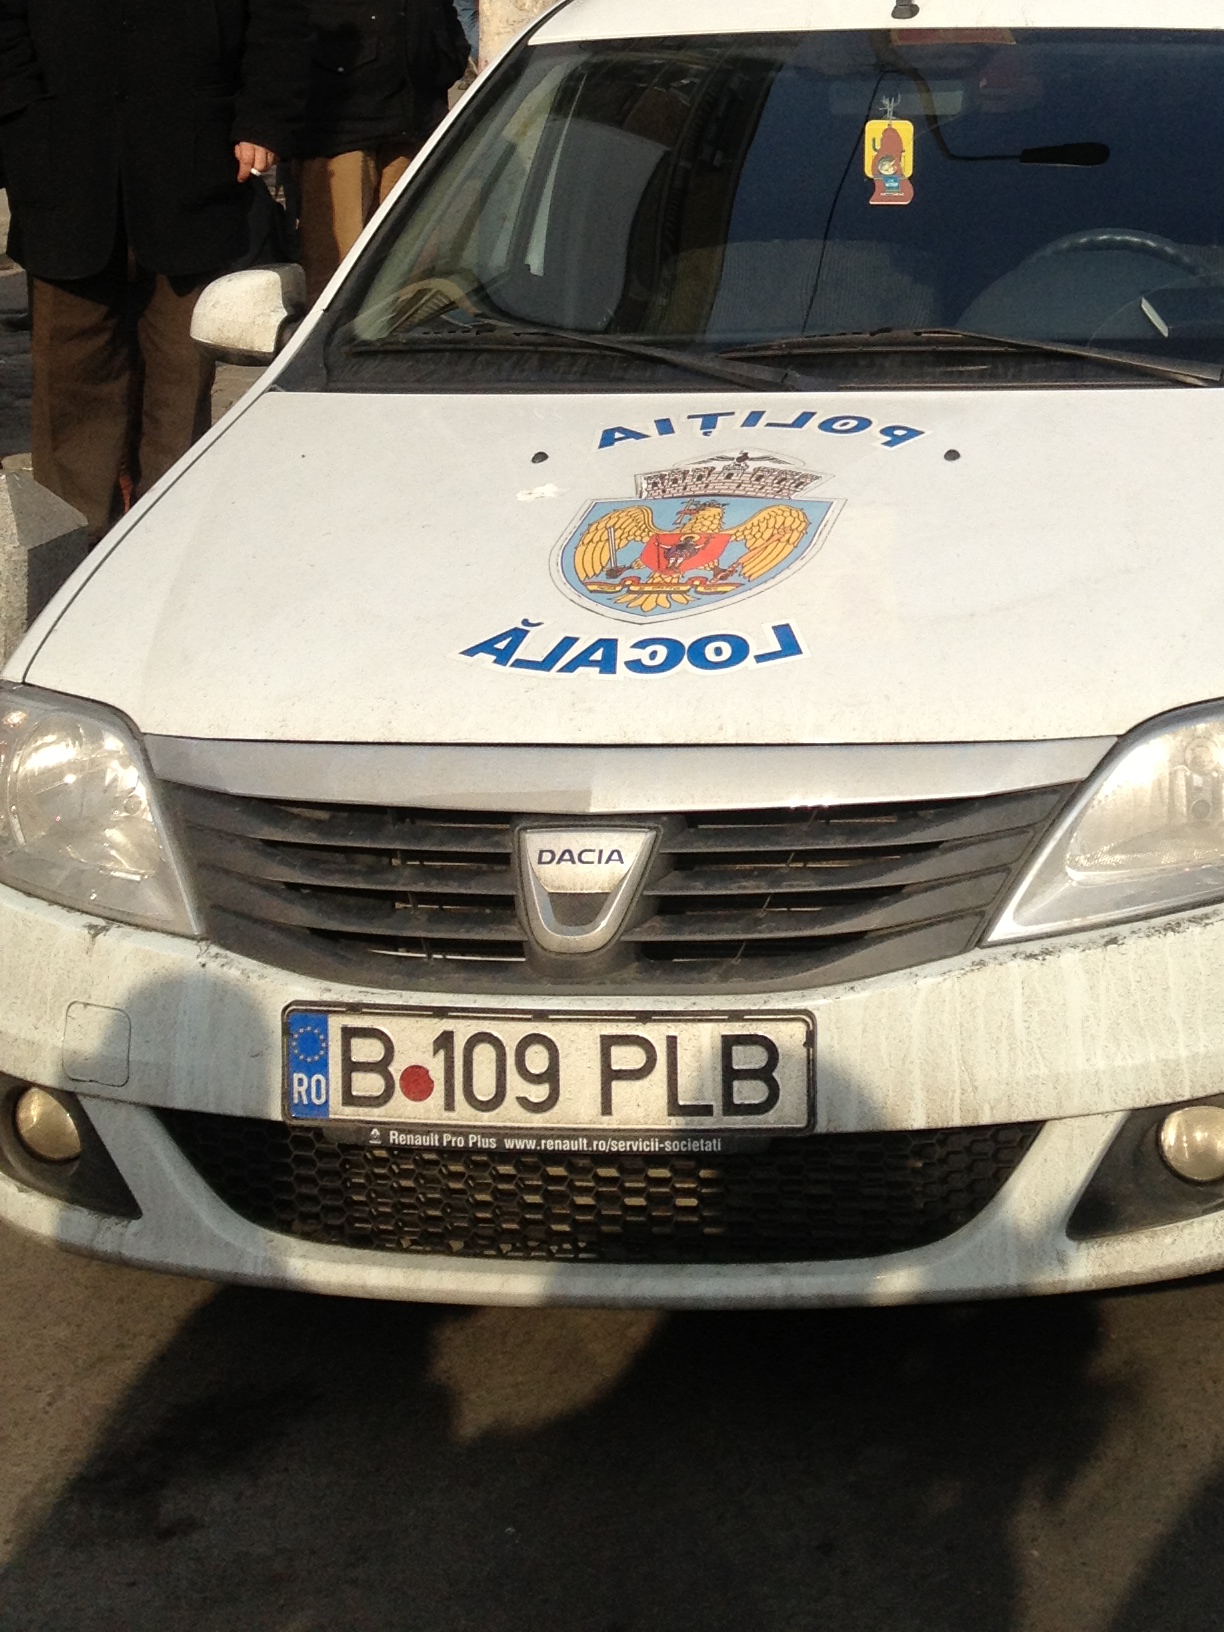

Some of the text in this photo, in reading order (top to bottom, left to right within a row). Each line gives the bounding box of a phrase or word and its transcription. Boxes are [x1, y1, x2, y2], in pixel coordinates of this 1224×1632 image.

[537, 849, 624, 865] DACIA
[341, 1026, 780, 1118] B 109 PLB
[292, 1072, 326, 1105] RO
[389, 1130, 721, 1153] Renault Pro Plus www.renault.ro/servicii-societati
